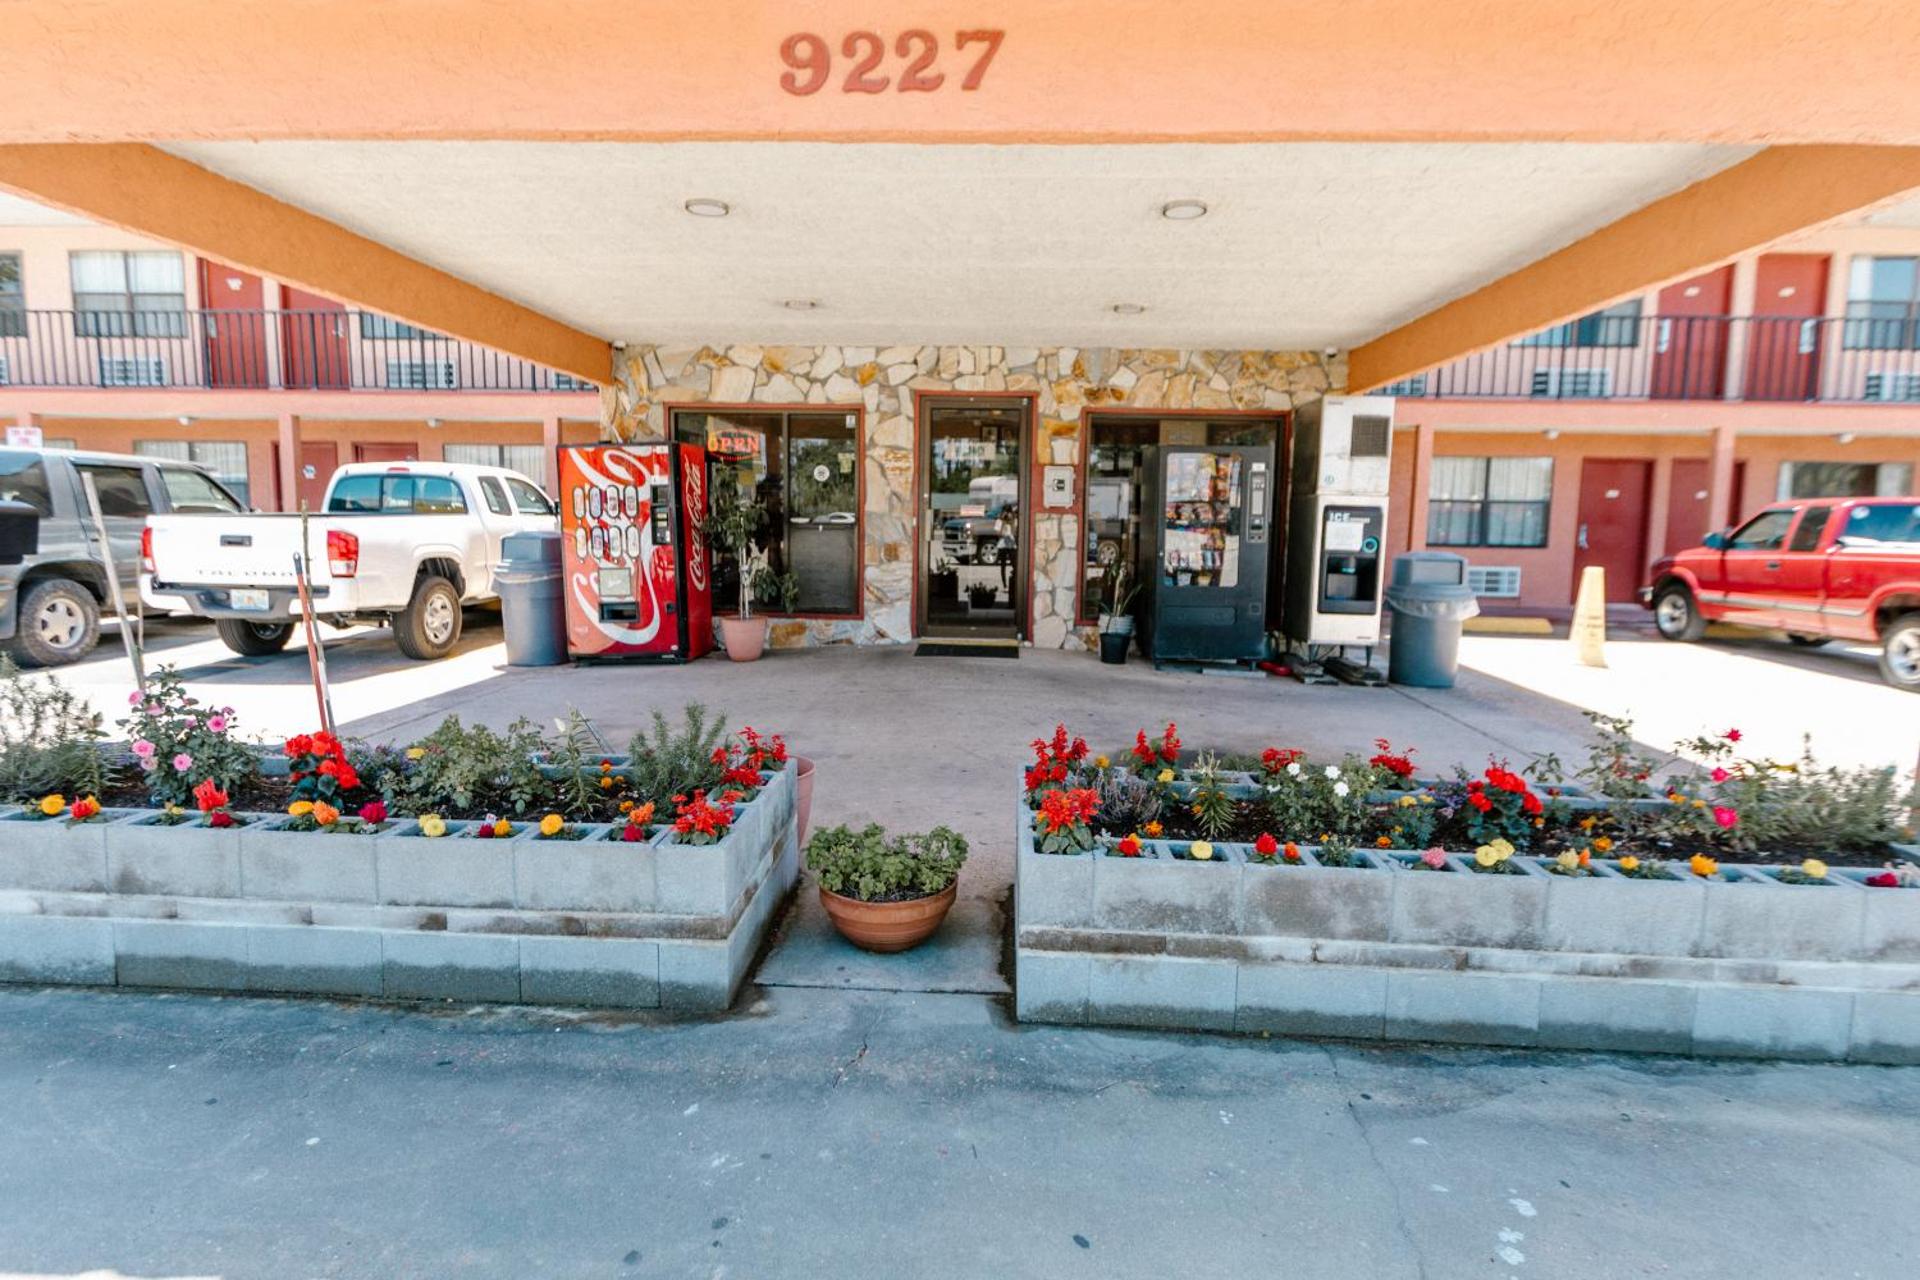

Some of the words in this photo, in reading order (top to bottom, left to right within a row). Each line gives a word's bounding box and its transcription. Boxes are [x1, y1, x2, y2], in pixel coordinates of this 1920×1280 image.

[780, 29, 1005, 96] 9227
[707, 433, 759, 453] OPEN
[1328, 511, 1351, 522] ICE
